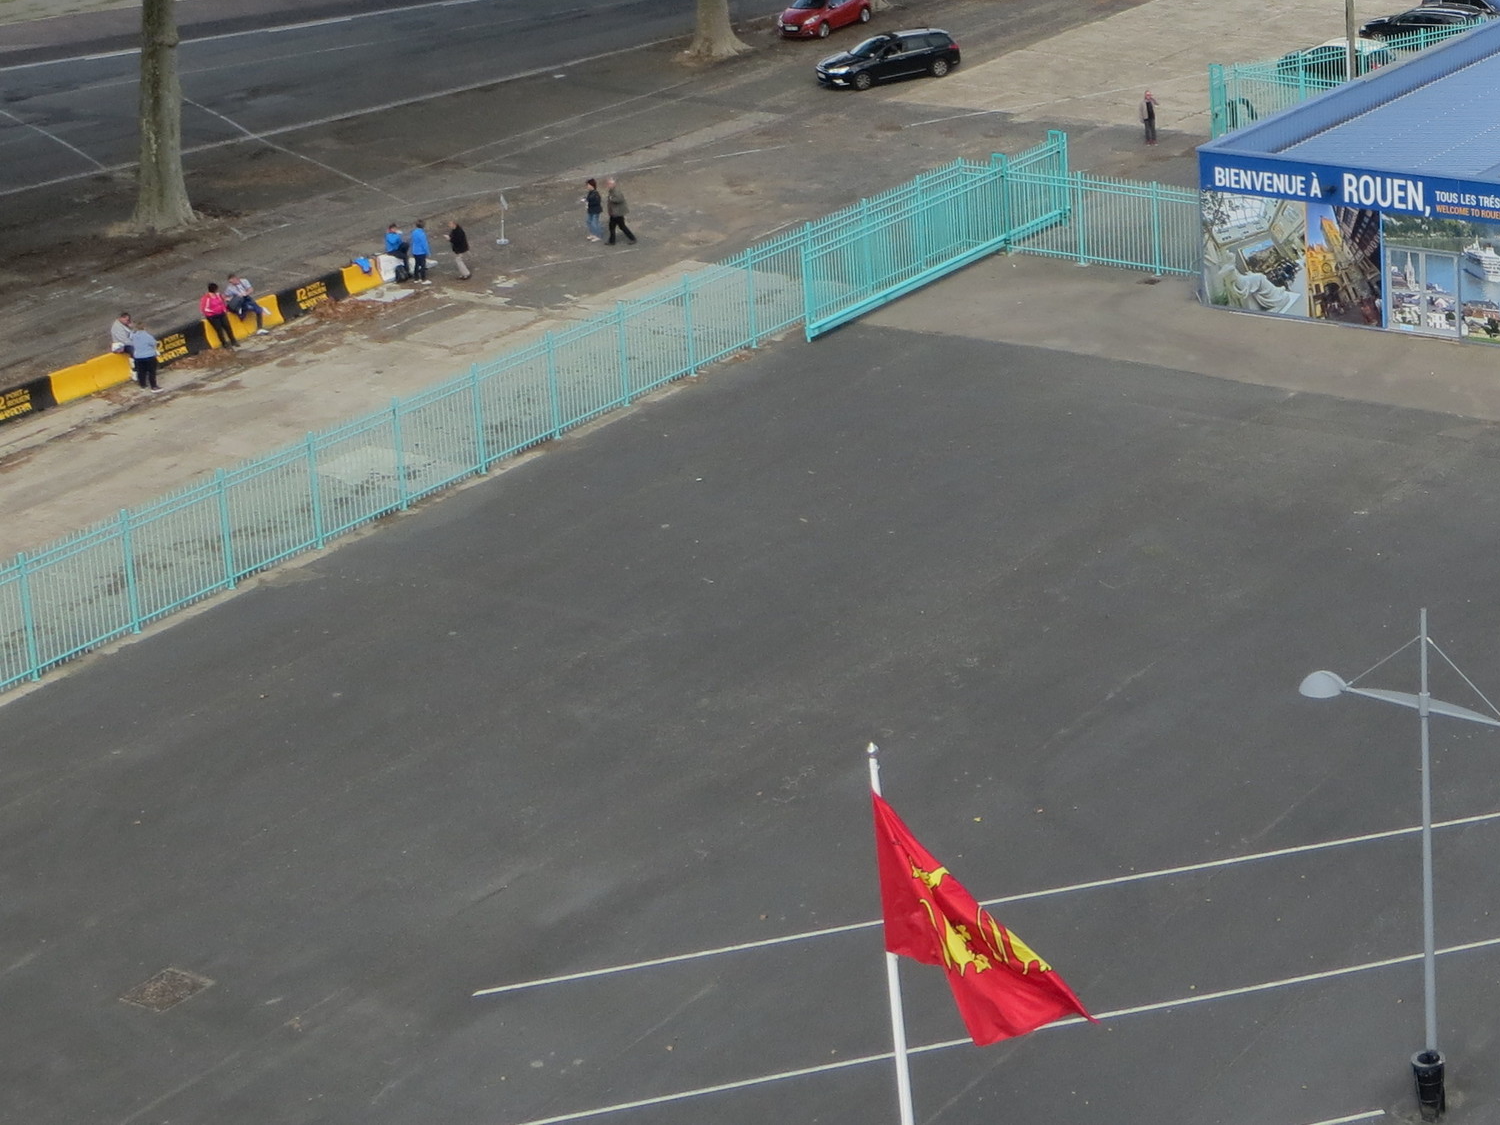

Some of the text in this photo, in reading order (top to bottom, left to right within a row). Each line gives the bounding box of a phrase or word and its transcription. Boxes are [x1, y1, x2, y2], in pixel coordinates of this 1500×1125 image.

[1215, 166, 1431, 217] BIENVENUE À ROUEN,
[1435, 191, 1459, 204] TOUS
[1460, 193, 1477, 206] LES
[1436, 205, 1470, 216] WELCOME
[1471, 208, 1480, 217] TO
